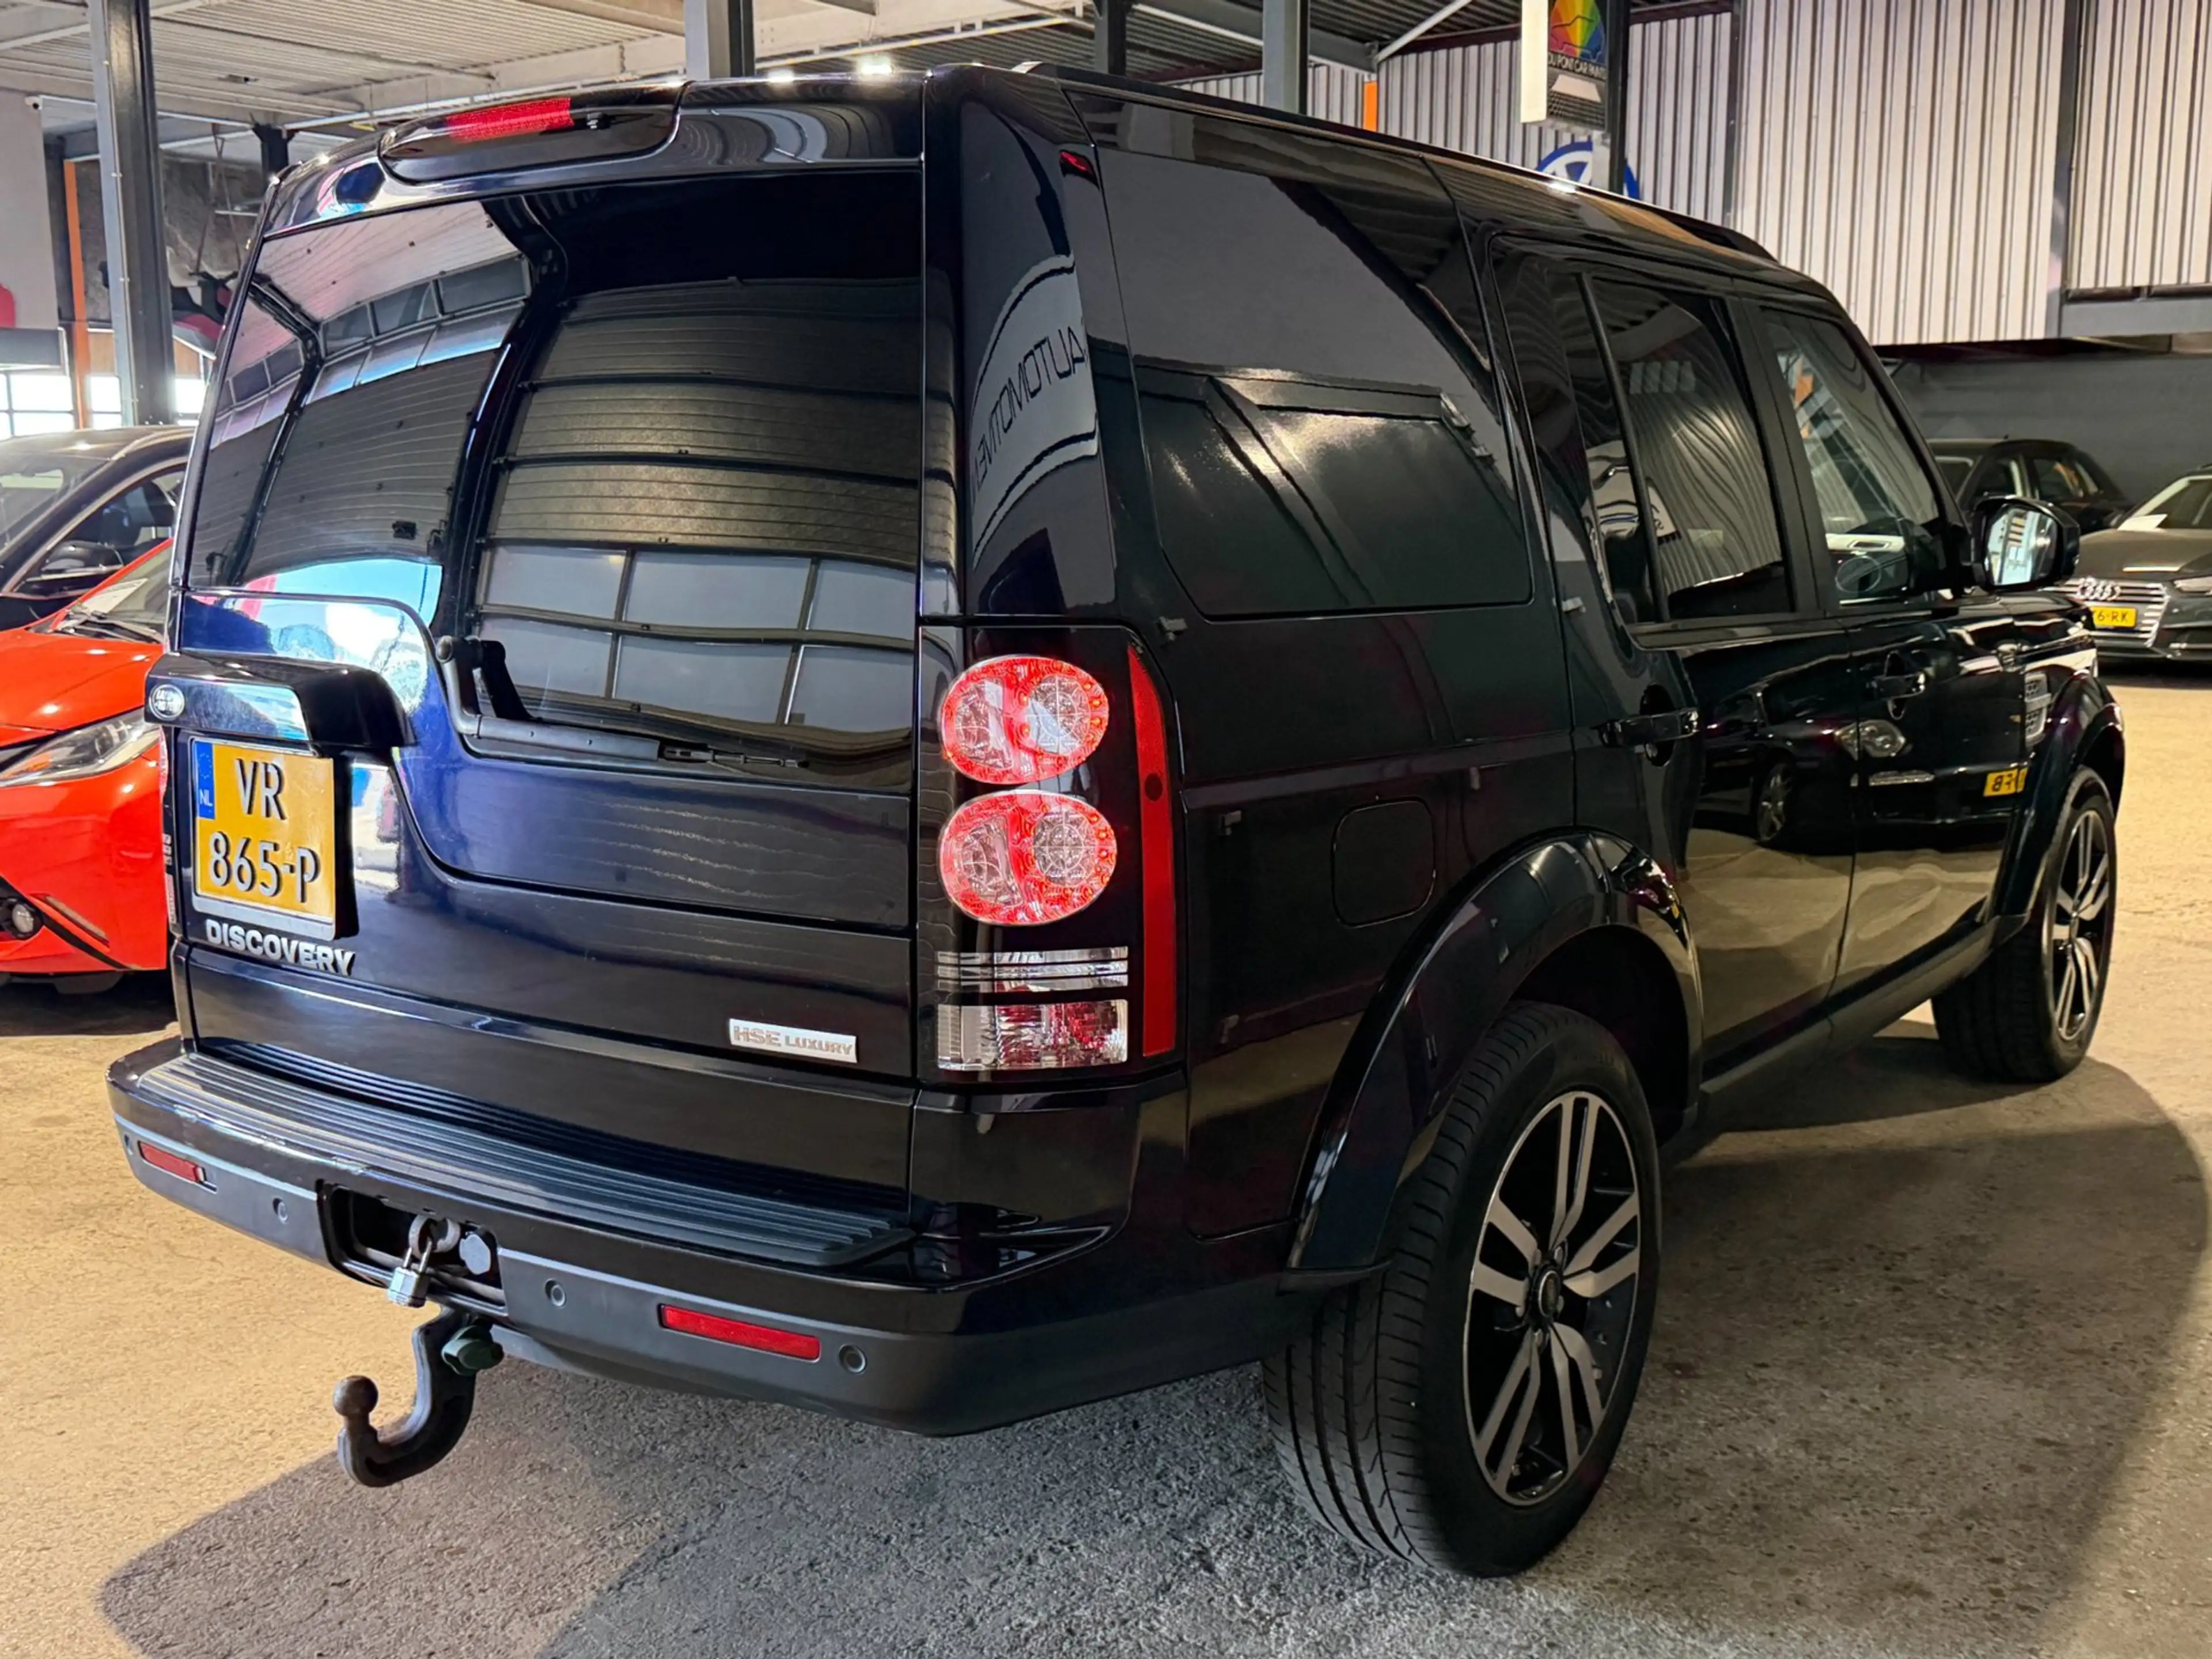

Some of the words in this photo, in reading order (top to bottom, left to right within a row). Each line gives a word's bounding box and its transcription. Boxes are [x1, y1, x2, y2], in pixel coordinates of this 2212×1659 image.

[2093, 610, 2128, 623] 6-RK
[199, 789, 213, 807] NL
[236, 758, 287, 821] VR
[209, 831, 321, 903] 865-P
[206, 919, 356, 976] DISCOVERY
[733, 1025, 781, 1047] HSE
[785, 1035, 853, 1055] LUXURY
